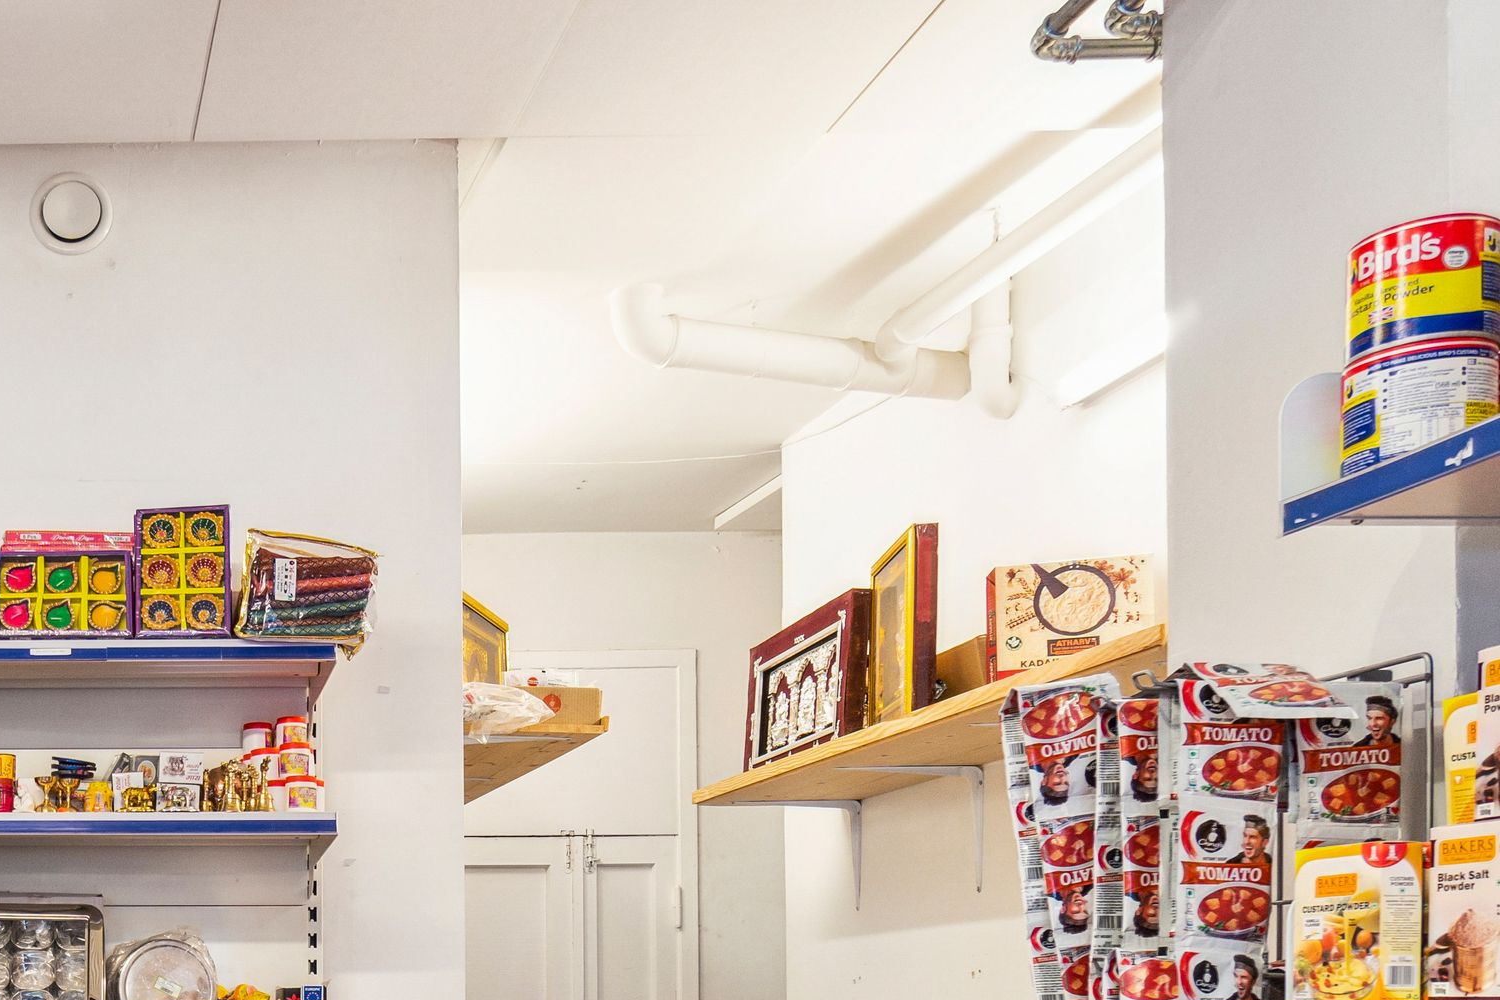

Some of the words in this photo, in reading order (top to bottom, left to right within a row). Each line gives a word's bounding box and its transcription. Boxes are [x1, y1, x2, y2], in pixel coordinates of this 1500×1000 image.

[1358, 231, 1442, 282] Bird's
[1056, 637, 1092, 647] ATHARV
[1020, 657, 1059, 668] KADA
[1203, 727, 1272, 742] TOMATO
[1319, 749, 1391, 768] TOMATO
[1451, 751, 1476, 762] CUSTA
[1442, 837, 1494, 855] BAKERS
[1197, 866, 1263, 881] TOMATO
[1437, 872, 1465, 883] Black
[1468, 869, 1489, 880] Salt
[1318, 875, 1357, 889] BAKERS
[1437, 882, 1475, 893] Powder
[1302, 904, 1335, 914] CUSTARD
[1337, 901, 1370, 912] POWDER
